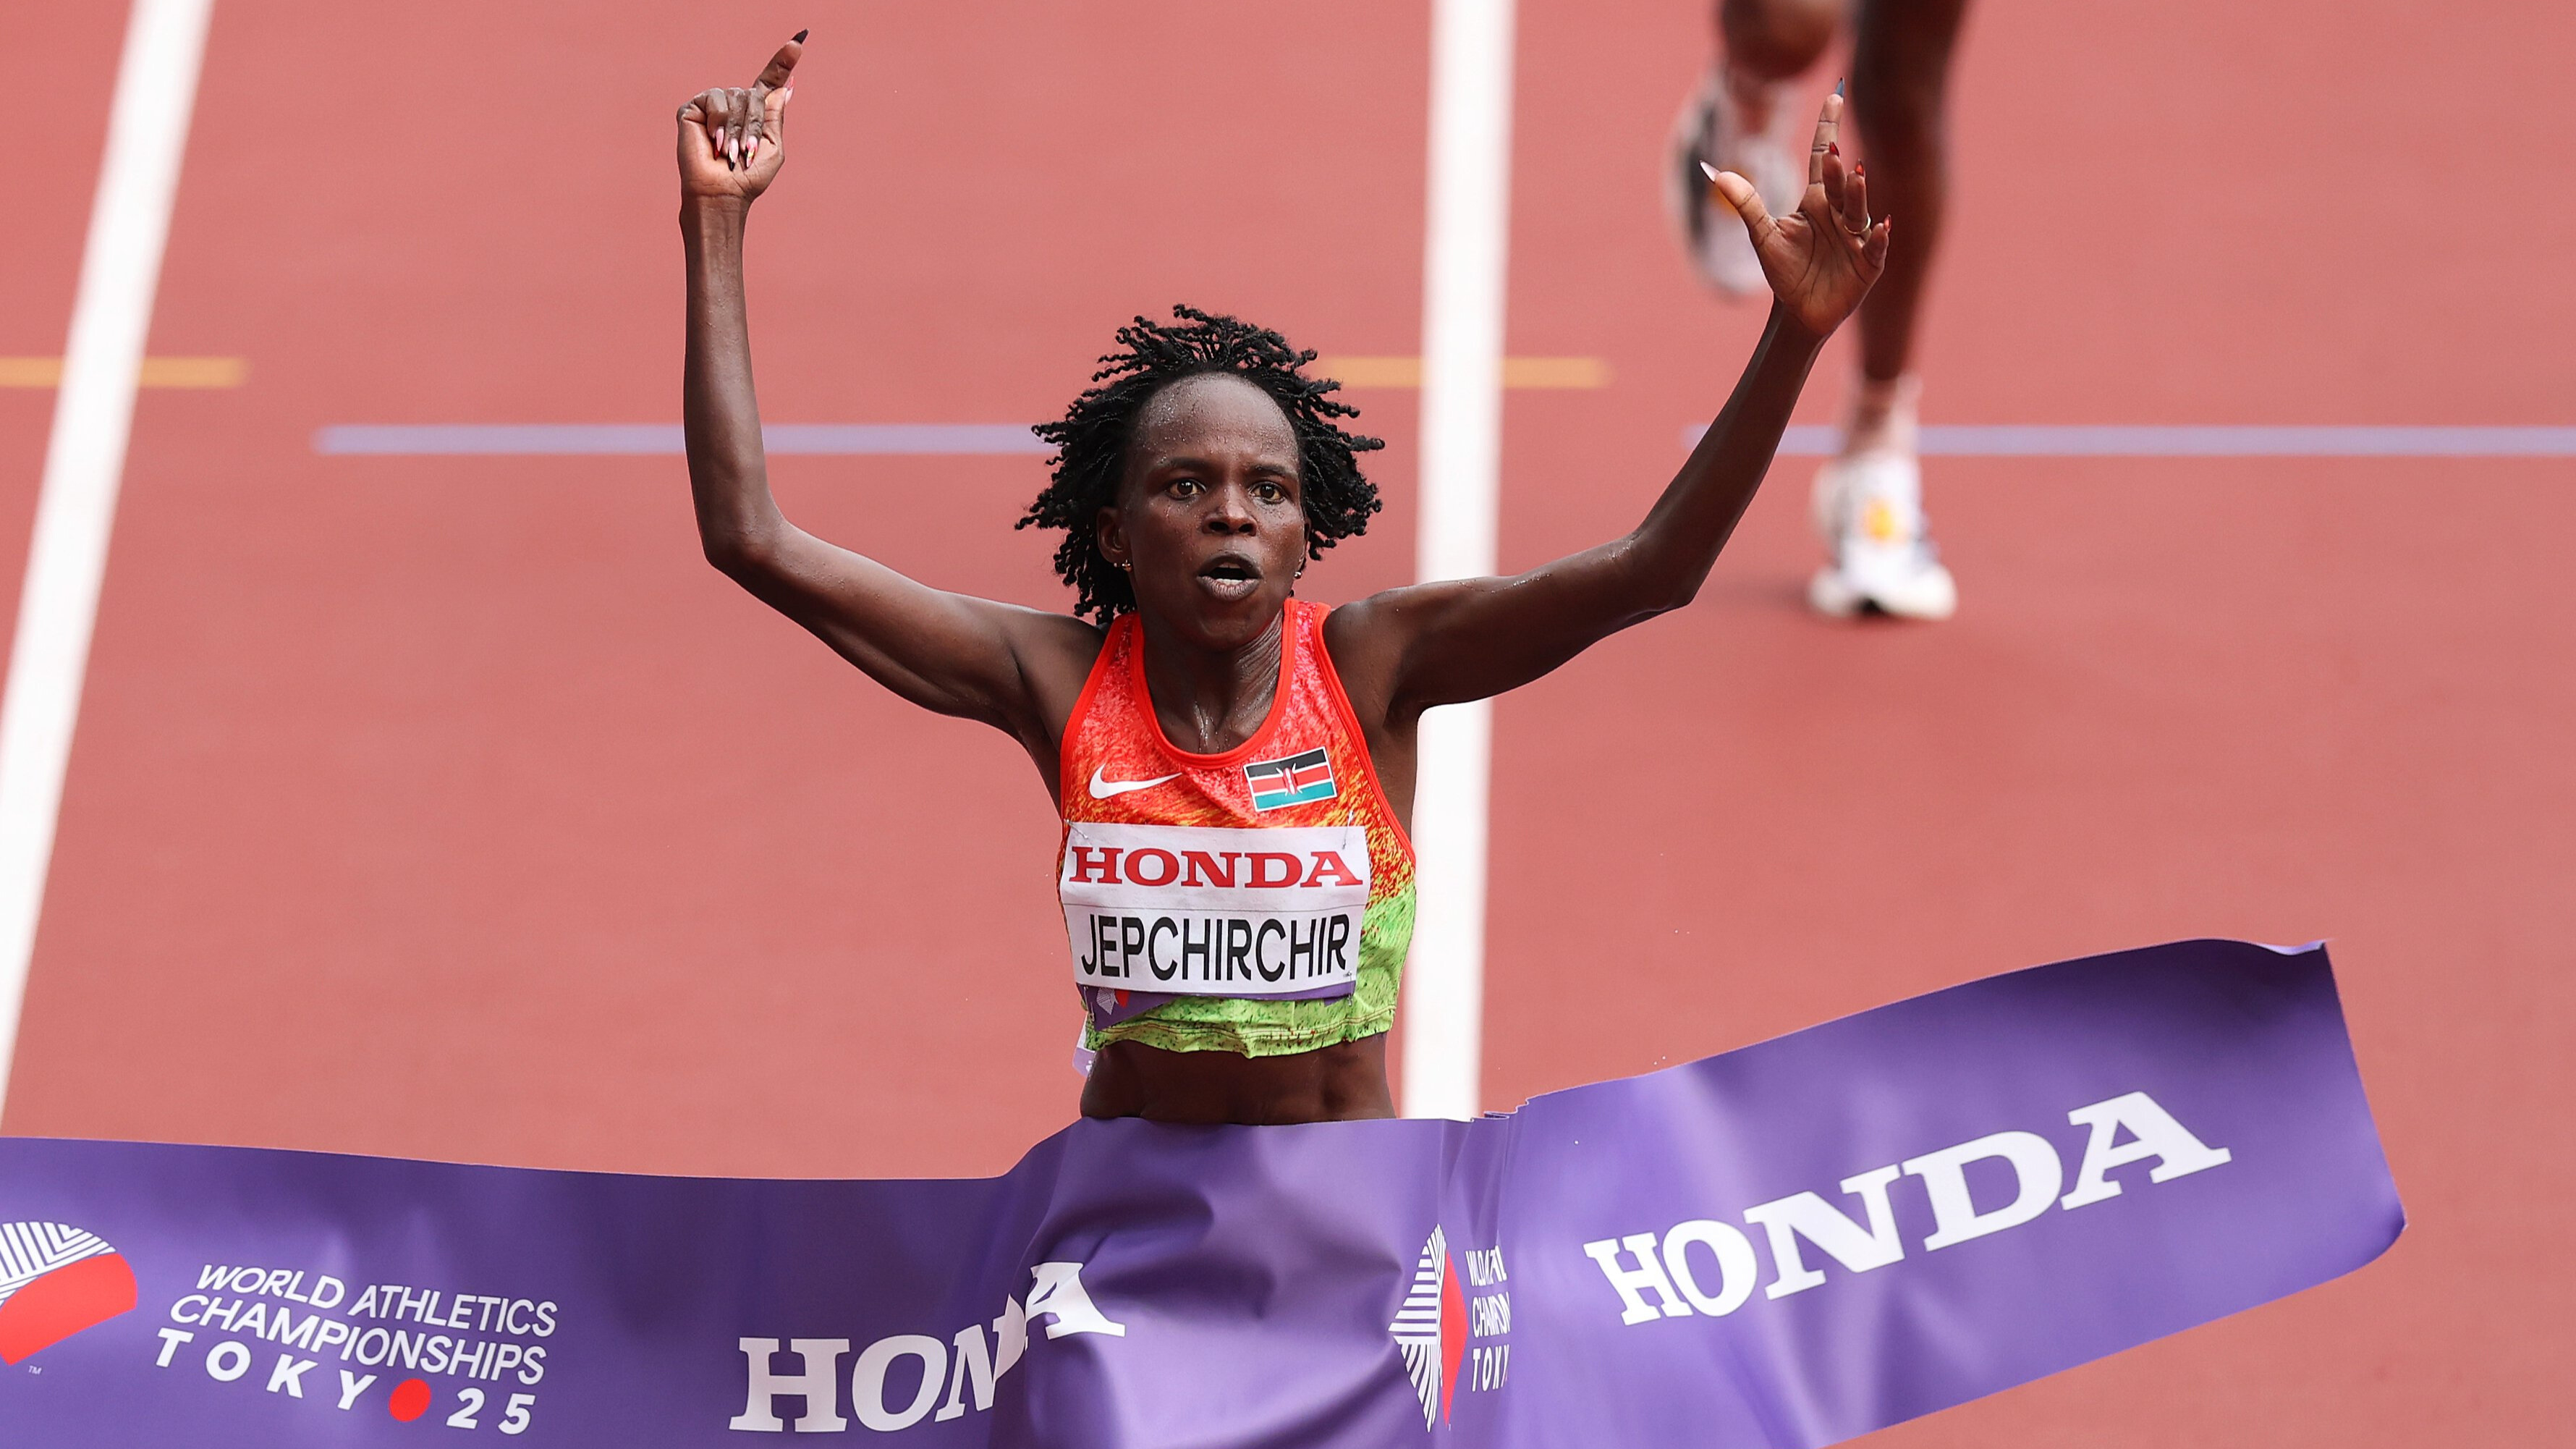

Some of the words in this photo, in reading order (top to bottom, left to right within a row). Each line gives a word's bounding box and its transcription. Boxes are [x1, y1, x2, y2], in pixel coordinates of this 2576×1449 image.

[1069, 845, 1364, 888] HONDA
[1080, 913, 1350, 983] JEPCHIRCHIR
[1583, 1091, 2232, 1327] HONDA
[195, 1264, 346, 1310] WORLD
[347, 1284, 559, 1338] ATHLETICS
[169, 1293, 547, 1385] CHAMPIONSHIPS
[445, 1387, 536, 1435] 25
